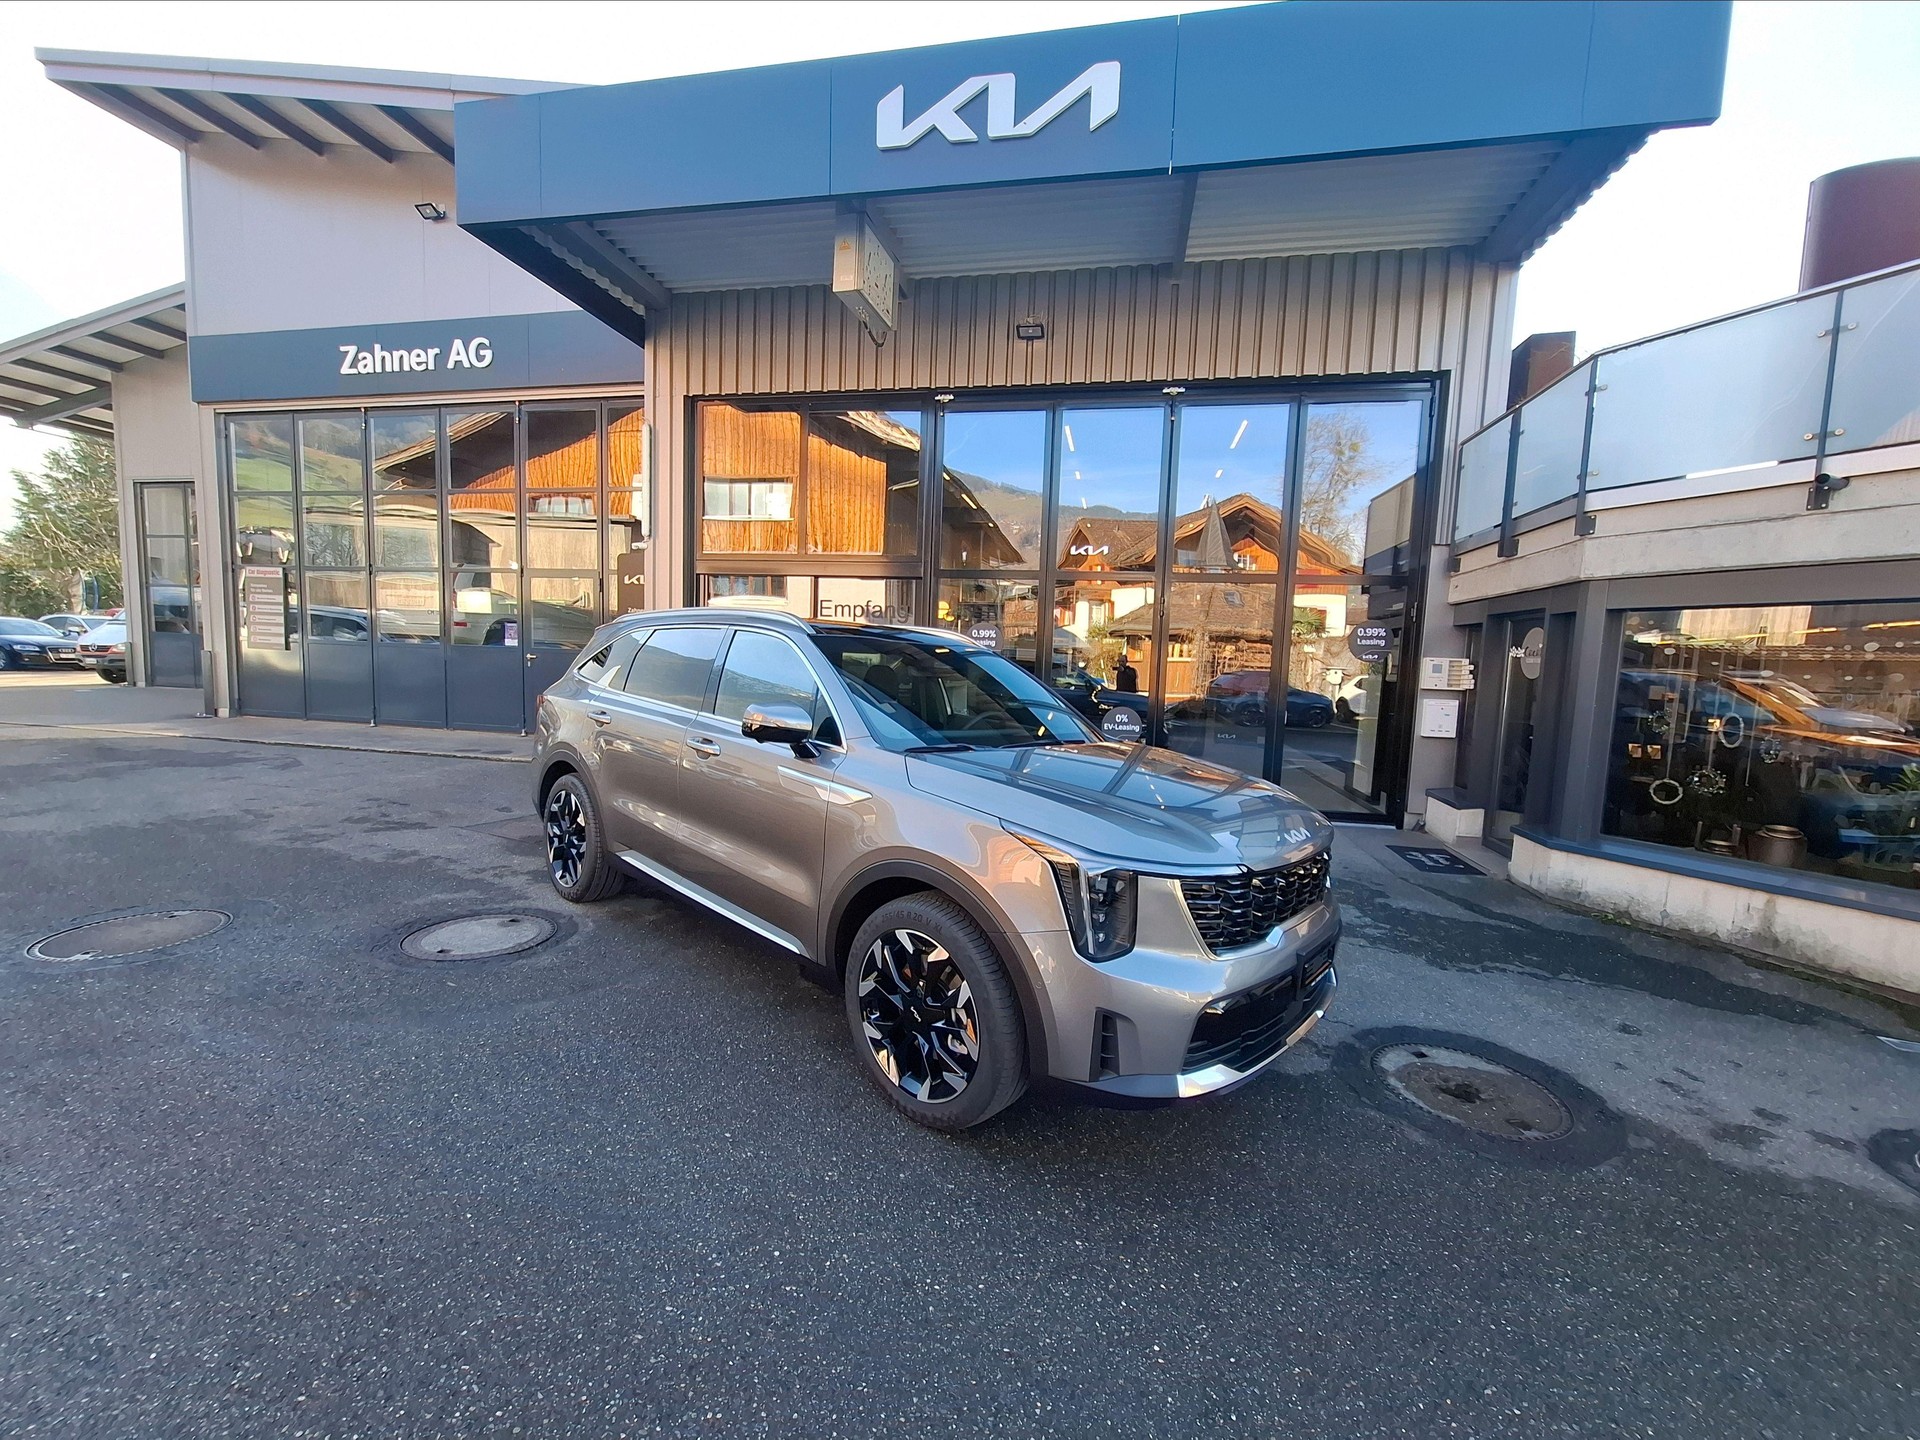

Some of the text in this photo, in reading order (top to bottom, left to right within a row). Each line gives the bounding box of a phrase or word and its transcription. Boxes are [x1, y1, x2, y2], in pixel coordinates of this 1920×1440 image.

[876, 60, 1121, 150] KIA
[339, 336, 494, 375] Zahner AG
[1070, 545, 1109, 556] KIA
[819, 600, 910, 624] Empfang
[972, 629, 997, 638] 0.99%
[1357, 627, 1387, 637] 0.99%
[1357, 638, 1386, 647] Leasing
[1115, 714, 1129, 723] 0%
[1103, 723, 1140, 733] EV-Leasing
[1283, 826, 1312, 844] KIA
[913, 912, 923, 923] 20
